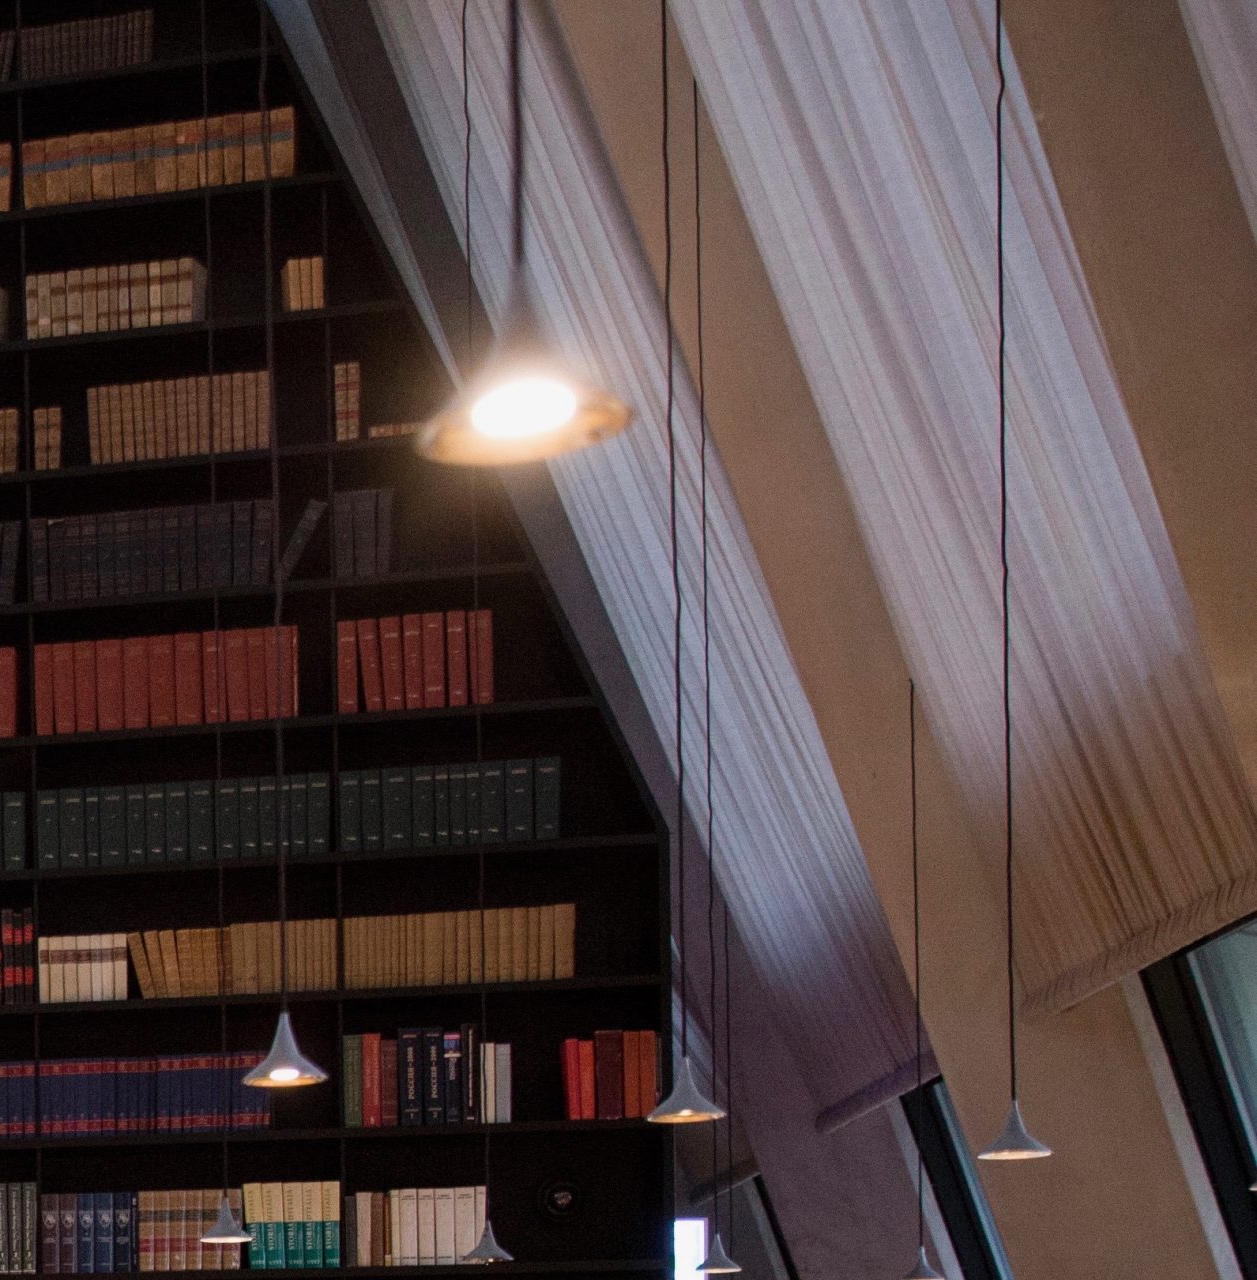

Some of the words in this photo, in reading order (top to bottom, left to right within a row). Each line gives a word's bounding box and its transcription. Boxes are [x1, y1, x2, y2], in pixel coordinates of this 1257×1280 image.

[267, 1223, 276, 1251] STORIA
[287, 1222, 295, 1250] STORIA
[306, 1222, 314, 1250] STORIA
[325, 1222, 333, 1250] STORIA
